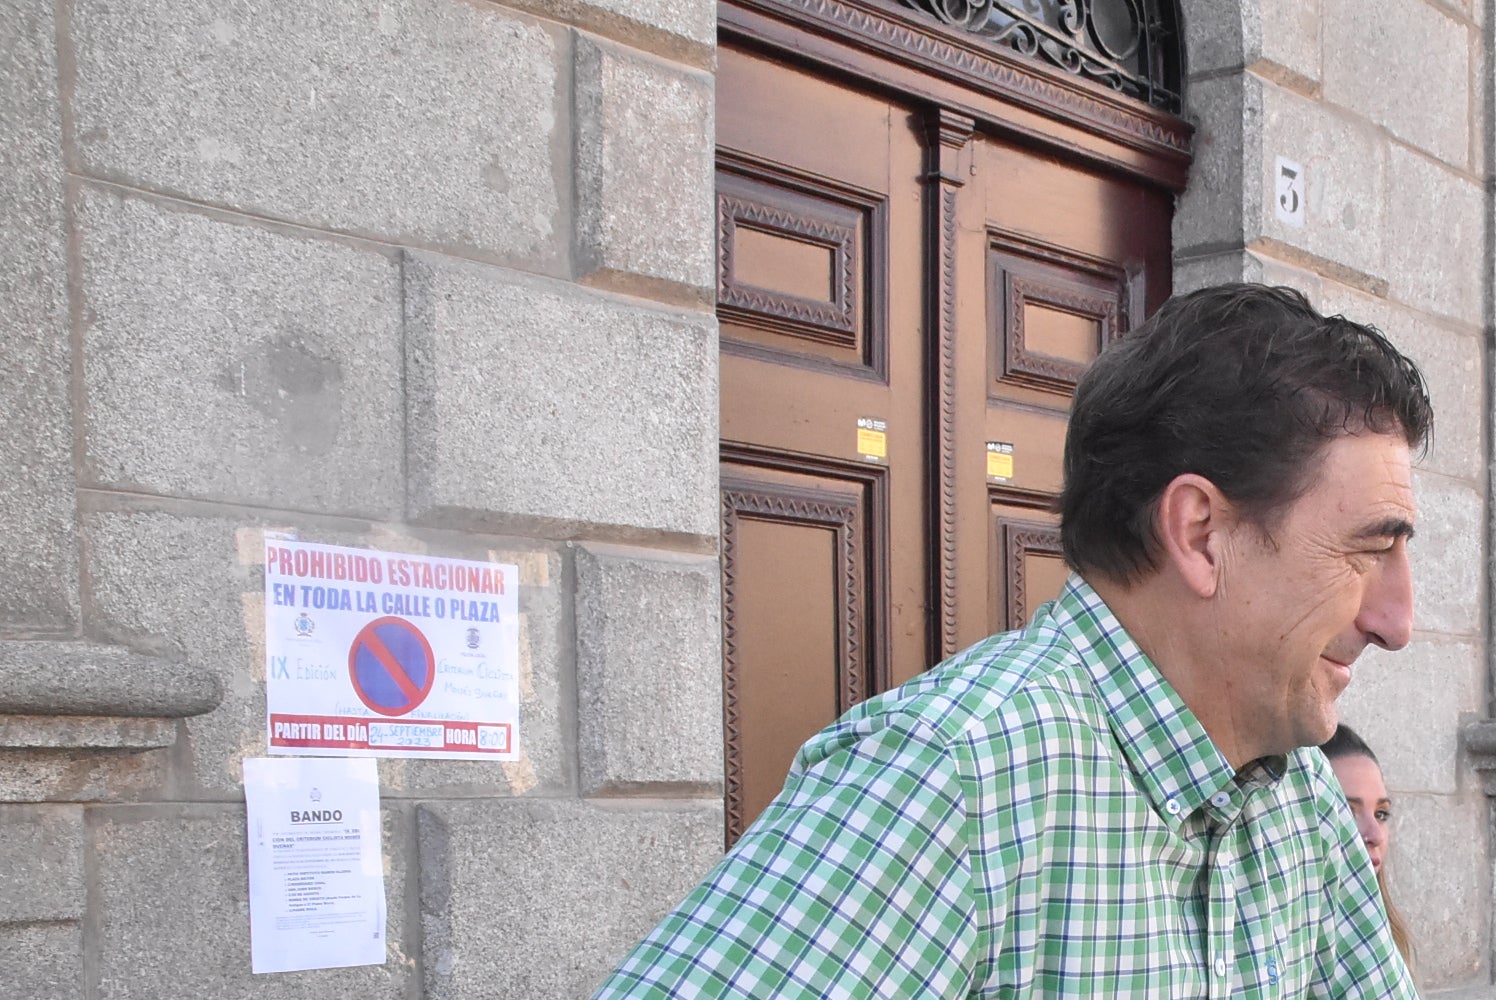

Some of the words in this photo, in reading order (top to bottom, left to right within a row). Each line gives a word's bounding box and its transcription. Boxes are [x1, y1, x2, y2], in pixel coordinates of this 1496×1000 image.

[1280, 165, 1299, 213] 3
[268, 546, 383, 584] PROHIBIDO
[387, 559, 505, 595] ESTACIONAR
[273, 583, 296, 606] EN
[300, 585, 352, 611] TODA
[356, 591, 377, 613] LA
[382, 592, 431, 618] CALLE
[434, 597, 446, 619] O
[450, 598, 500, 622] PLAZA
[271, 656, 290, 680] IX
[275, 722, 321, 740] PARTIR
[324, 724, 345, 741] DEL
[347, 723, 368, 742] DÍA
[446, 728, 477, 745] HORA
[290, 810, 343, 823] BANDO
